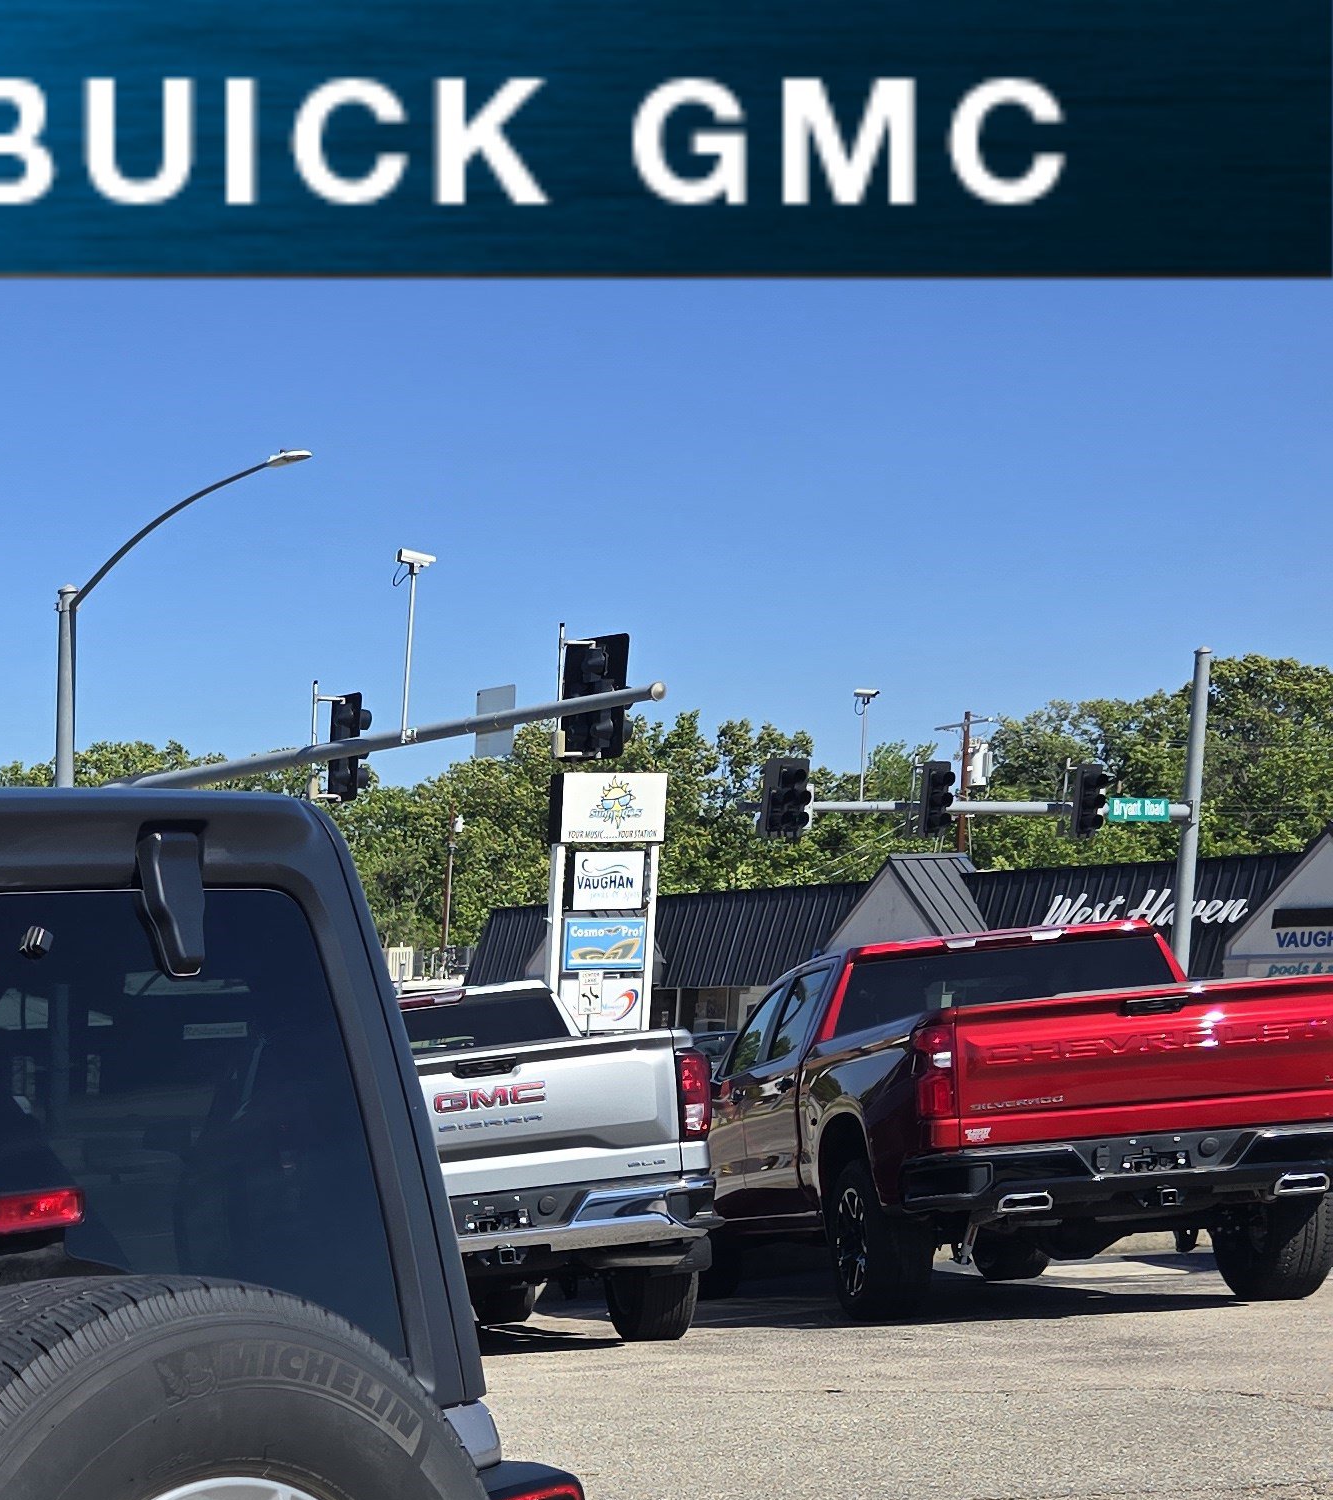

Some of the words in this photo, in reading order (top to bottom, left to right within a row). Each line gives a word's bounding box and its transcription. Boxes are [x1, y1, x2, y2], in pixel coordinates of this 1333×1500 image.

[1113, 799, 1142, 819] Bryant
[1144, 799, 1166, 817] Road
[634, 829, 658, 838] STATION
[576, 875, 634, 890] VAUGHAN
[1041, 893, 1126, 925] West
[570, 925, 605, 938] Cosmo
[621, 925, 644, 937] Prof
[984, 1018, 1329, 1064] CHEVROLET
[434, 1080, 547, 1114] GMC
[217, 1340, 423, 1442] MICHELIN
